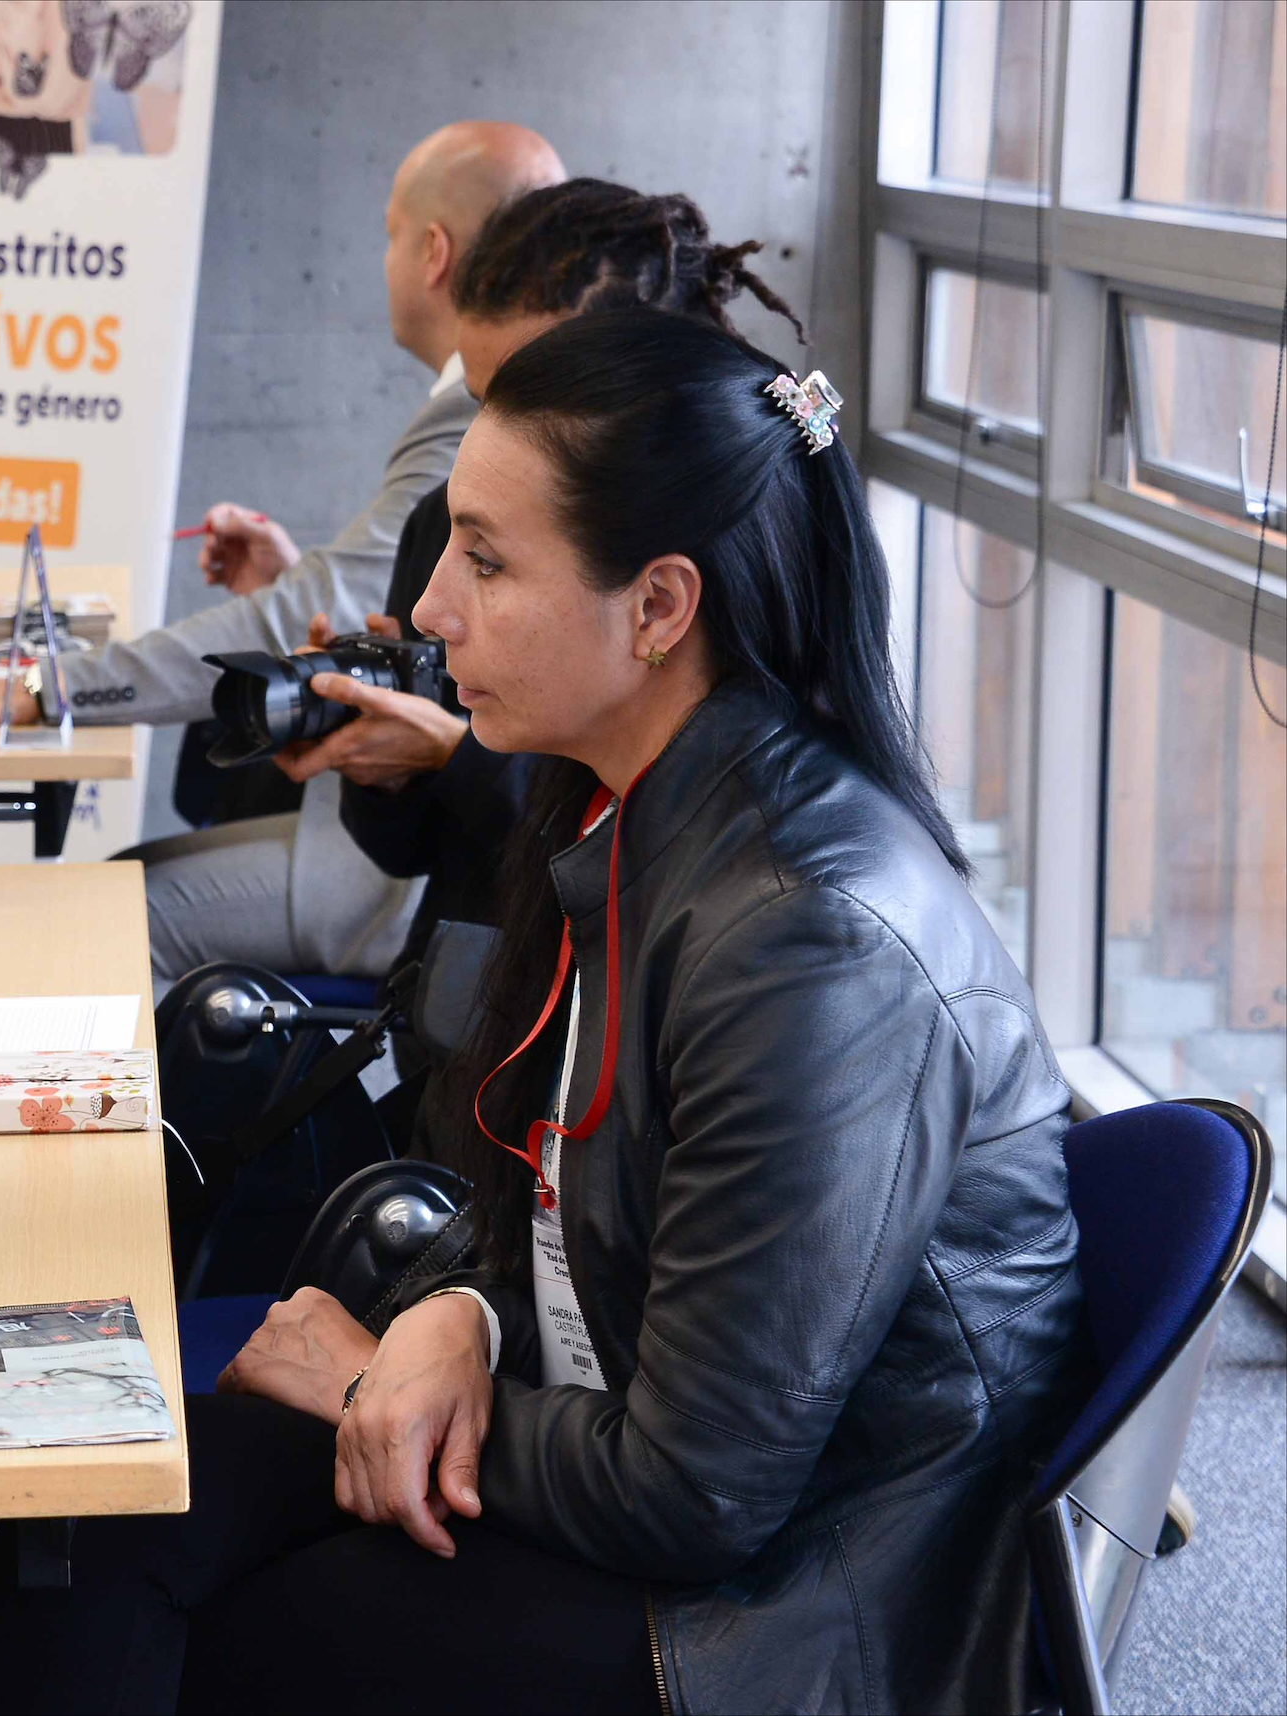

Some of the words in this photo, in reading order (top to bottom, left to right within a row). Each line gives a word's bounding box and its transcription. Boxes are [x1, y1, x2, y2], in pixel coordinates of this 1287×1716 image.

[15, 384, 122, 427] género
[548, 1305, 573, 1320] SANDRA
[555, 1320, 577, 1335] CASTRO
